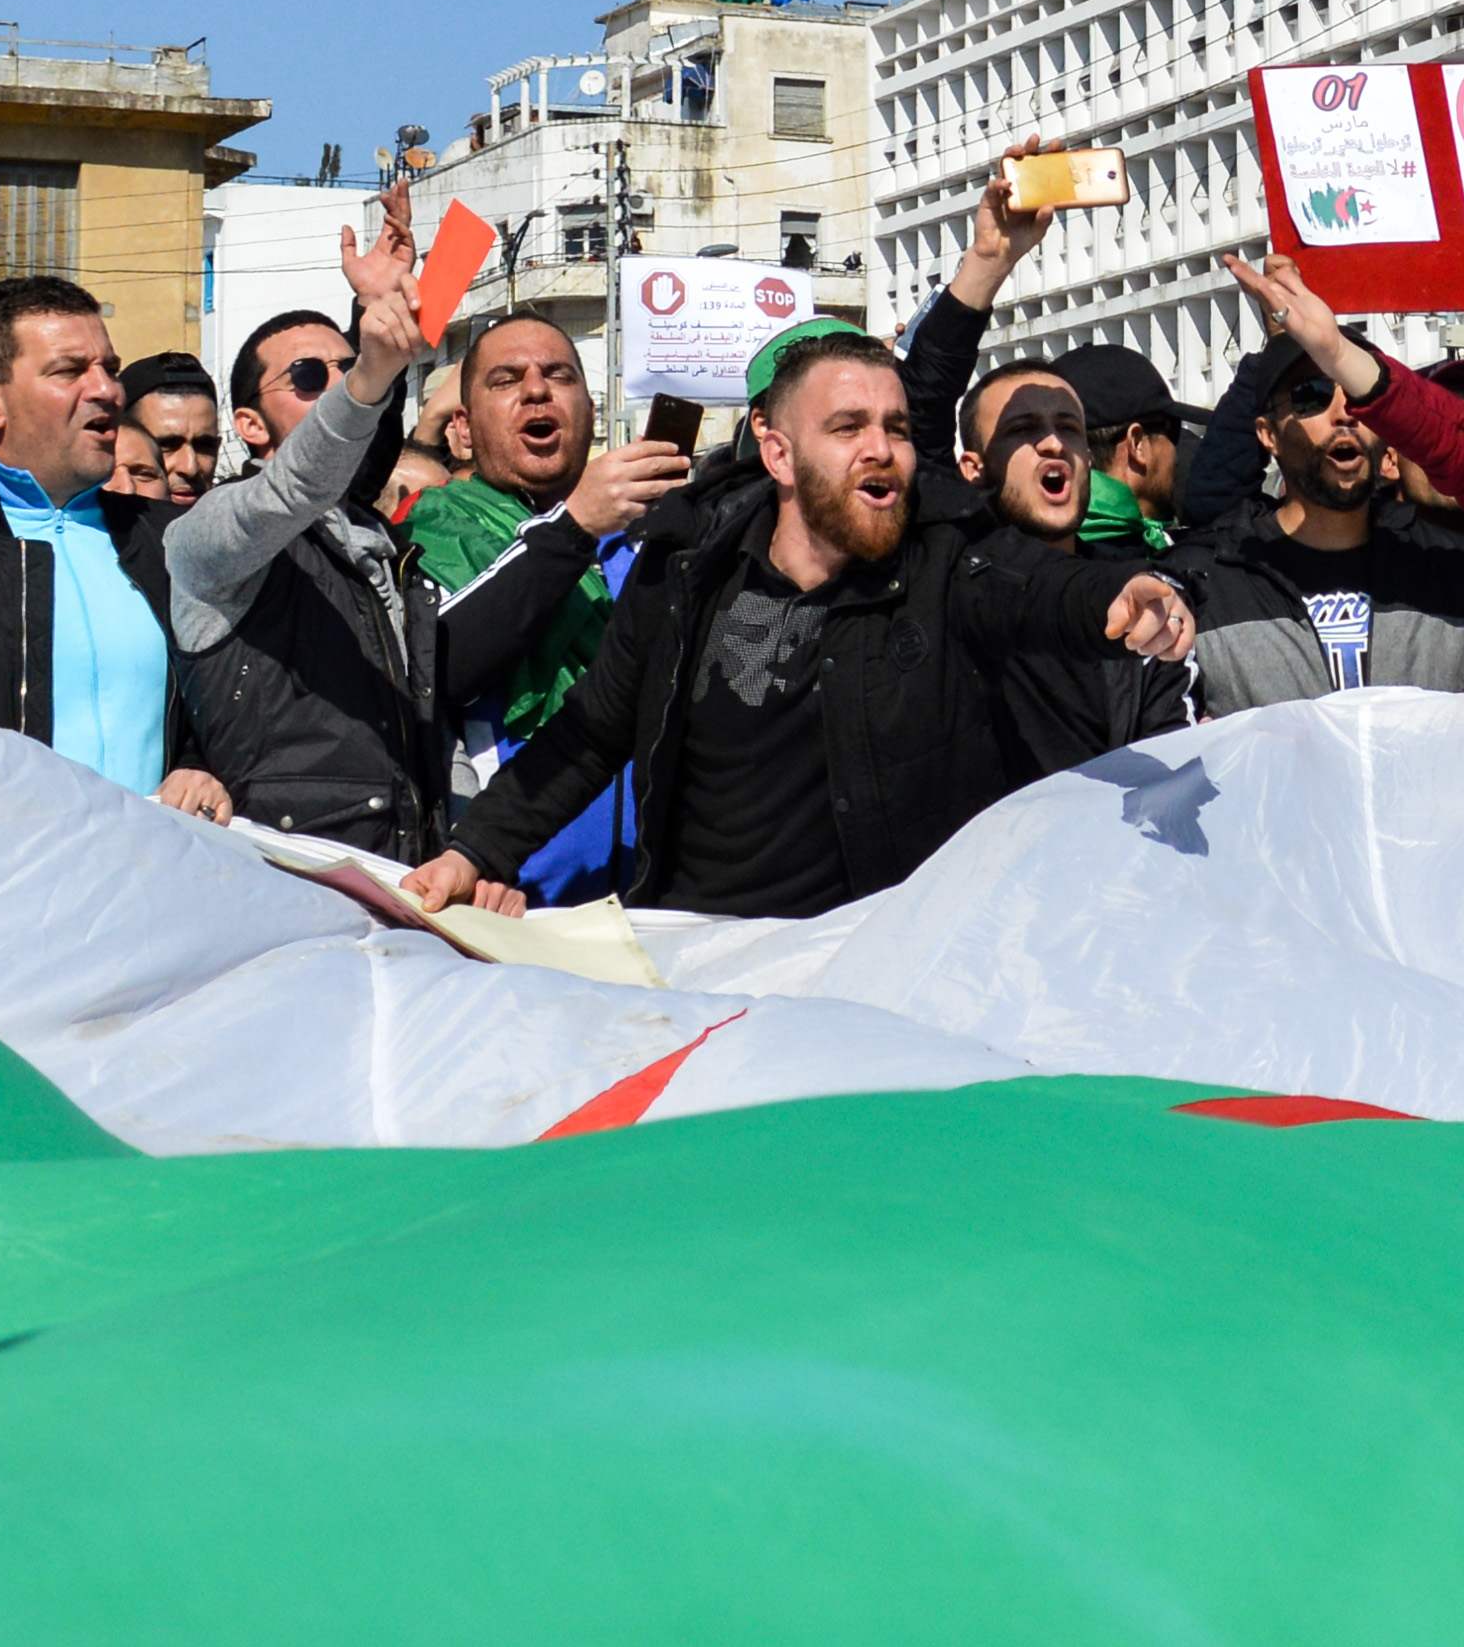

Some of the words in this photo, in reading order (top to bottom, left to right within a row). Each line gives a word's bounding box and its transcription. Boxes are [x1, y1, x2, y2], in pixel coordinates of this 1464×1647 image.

[1312, 72, 1368, 112] 01
[1321, 115, 1369, 134] مارس
[756, 288, 795, 307] STOP
